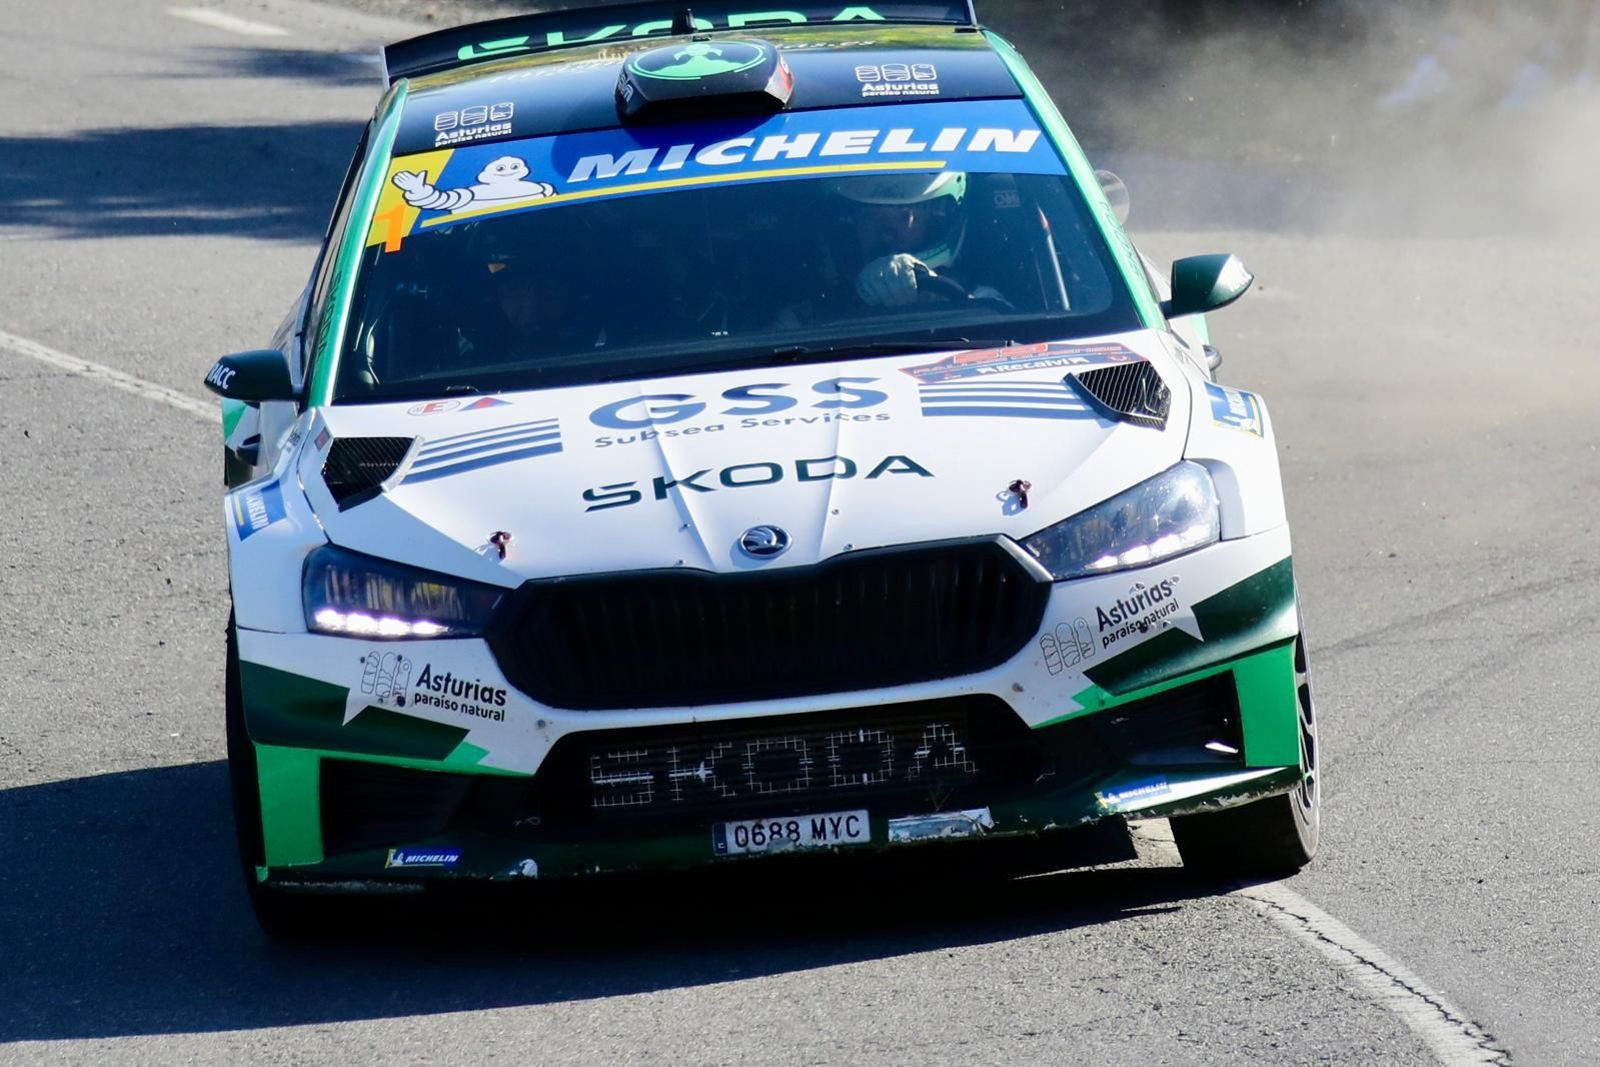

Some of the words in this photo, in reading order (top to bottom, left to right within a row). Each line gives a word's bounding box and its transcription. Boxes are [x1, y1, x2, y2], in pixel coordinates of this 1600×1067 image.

[862, 83, 939, 92] Asturias
[435, 123, 512, 141] Asturias
[566, 128, 1042, 184] MICHELIN
[373, 203, 408, 253] 1
[588, 377, 889, 430] GSS
[594, 423, 725, 448] Subsea
[741, 413, 891, 429] Services
[582, 454, 935, 513] SKODA
[1095, 579, 1173, 633] Asturias
[415, 663, 507, 706] Asturias
[414, 692, 458, 711] paraíso
[460, 704, 505, 722] natural
[590, 722, 978, 808] SKODA
[734, 820, 801, 848] 0688
[810, 815, 860, 841] MYC
[405, 854, 459, 863] MICHELIN
